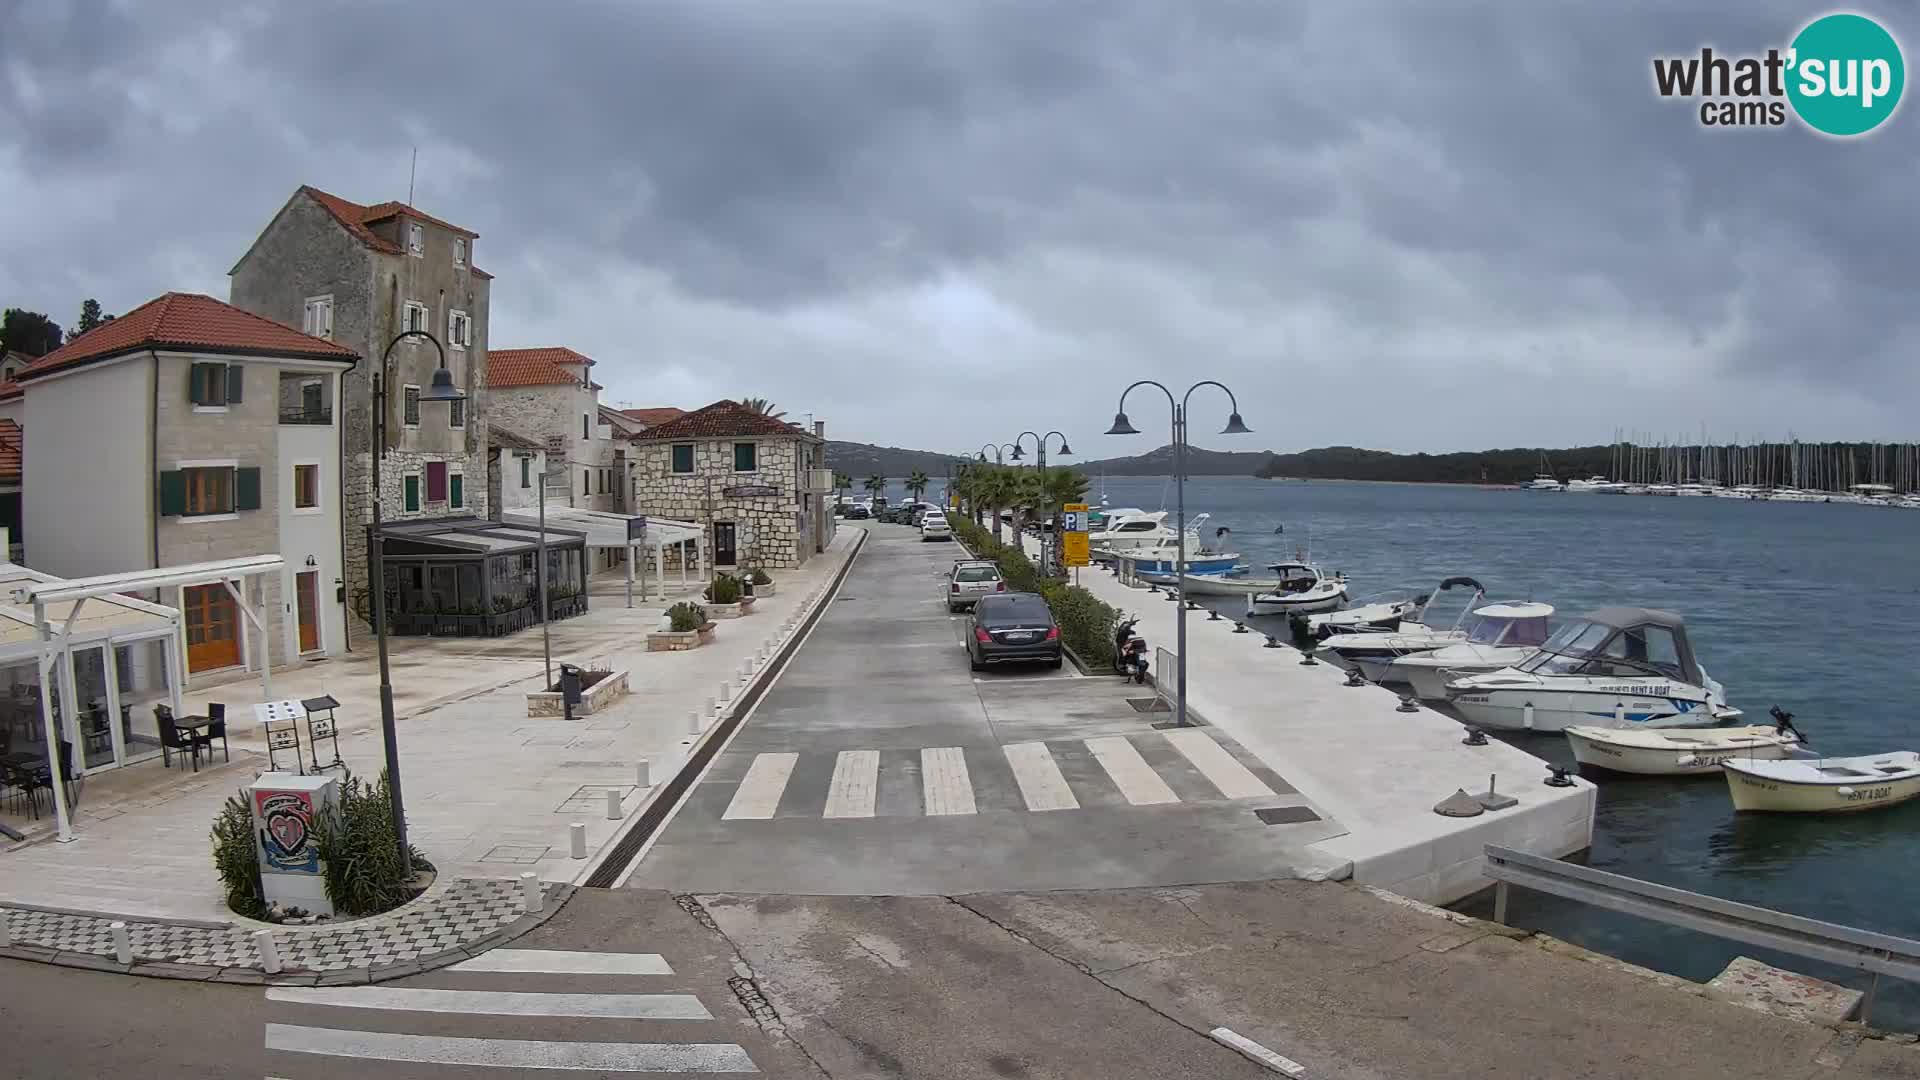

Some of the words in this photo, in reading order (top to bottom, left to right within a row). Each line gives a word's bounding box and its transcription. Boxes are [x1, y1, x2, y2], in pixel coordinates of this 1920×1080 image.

[1066, 513, 1076, 529] P
[1631, 686, 1648, 696] RENT
[1654, 686, 1671, 696] BOAT
[1873, 787, 1892, 799] BOAT
